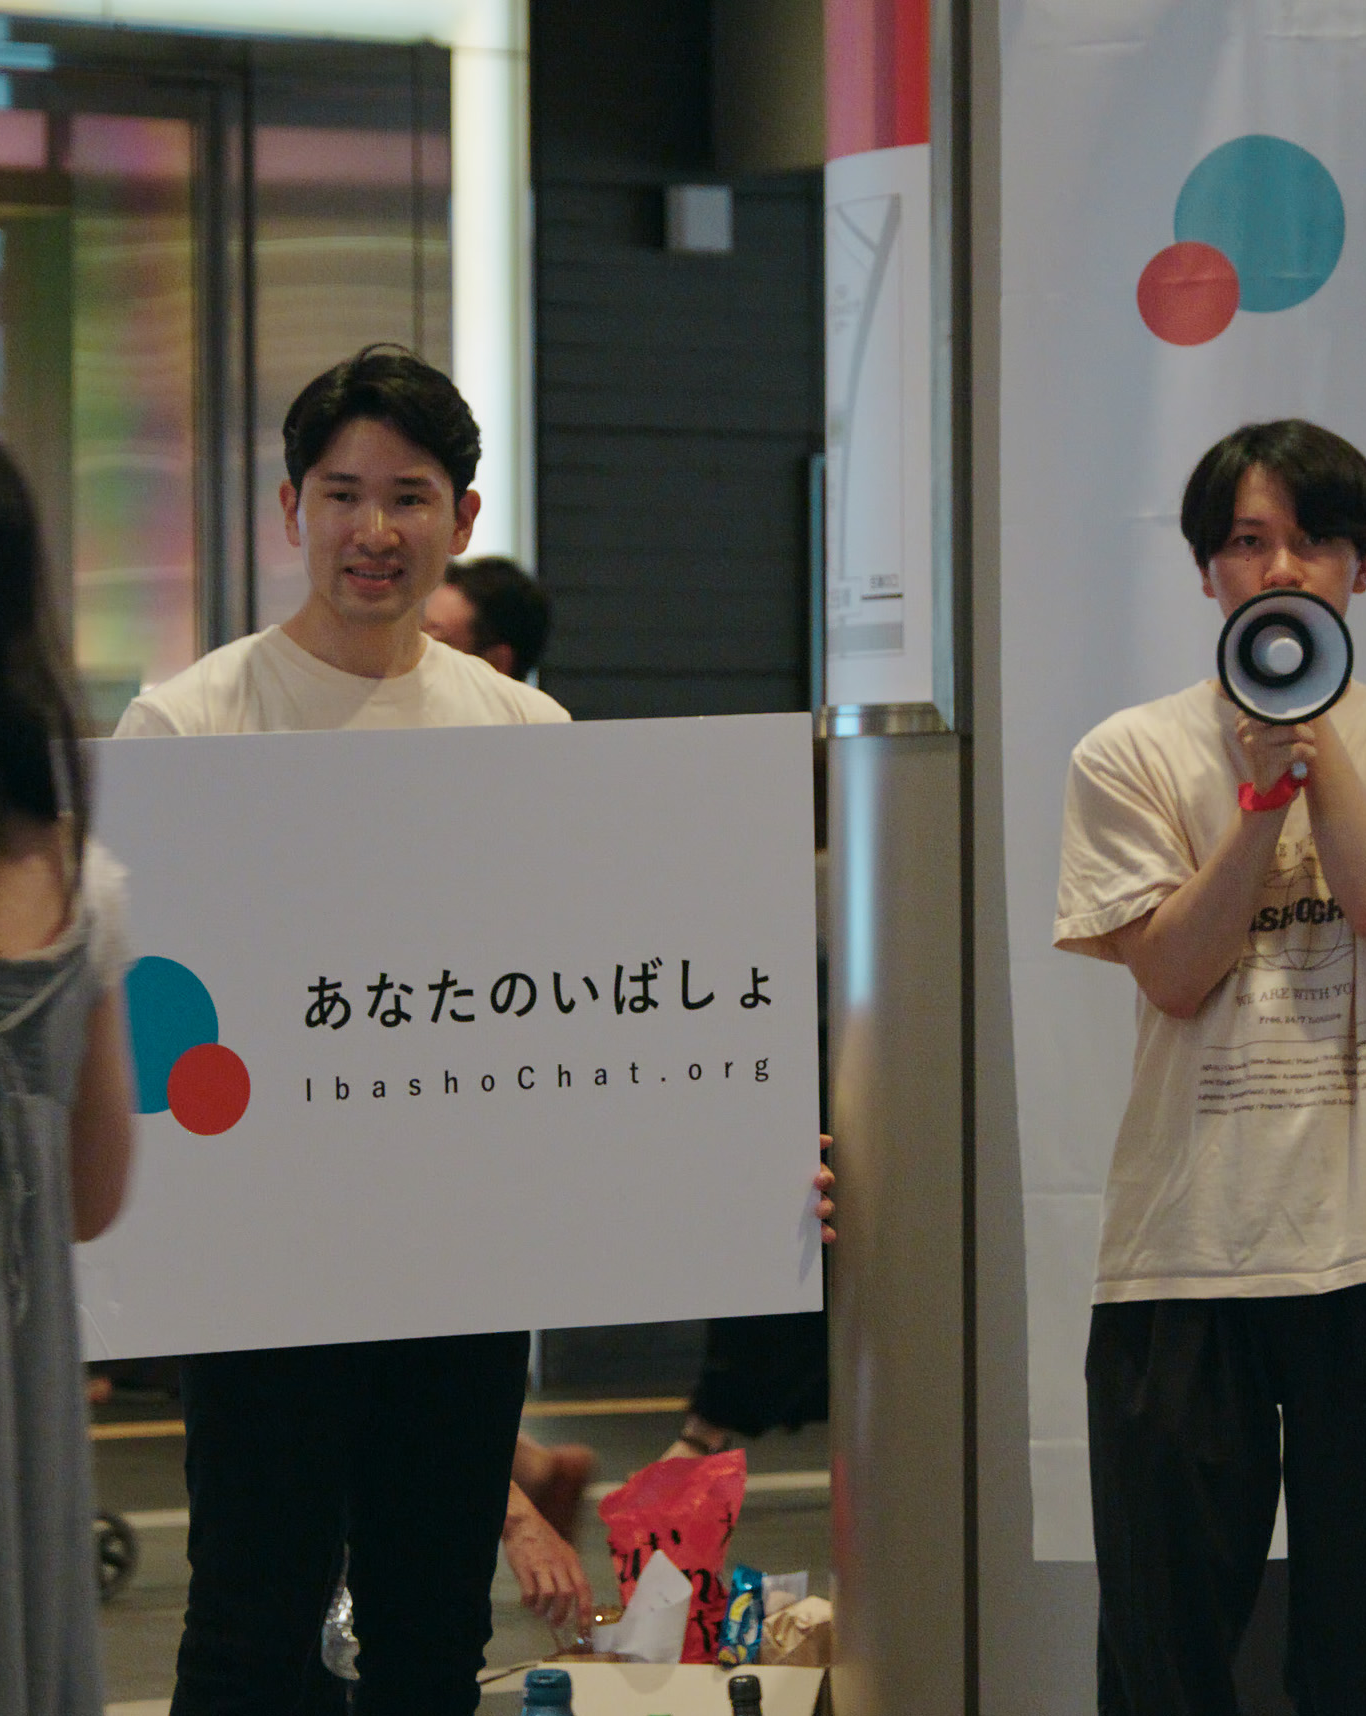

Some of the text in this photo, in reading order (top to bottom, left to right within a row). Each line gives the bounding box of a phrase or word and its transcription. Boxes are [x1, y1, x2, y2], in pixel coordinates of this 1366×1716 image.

[304, 956, 773, 1031] あなたのいばしょ
[306, 1056, 771, 1102] IbashoChat.org
